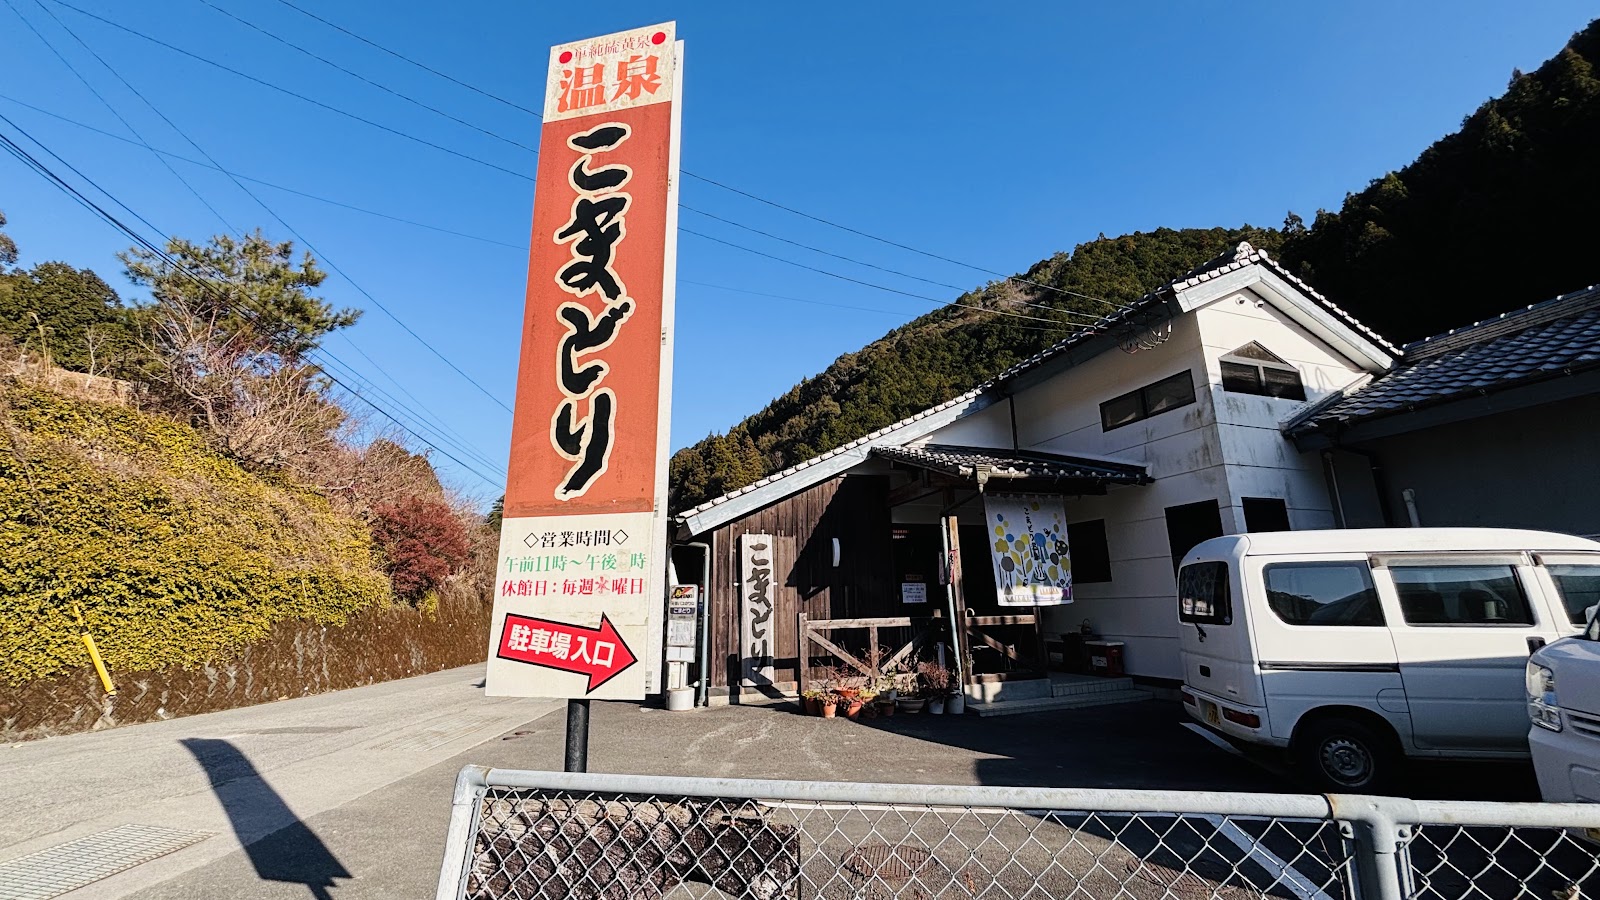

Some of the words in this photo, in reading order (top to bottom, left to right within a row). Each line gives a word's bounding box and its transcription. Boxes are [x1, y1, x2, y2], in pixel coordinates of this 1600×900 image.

[558, 55, 661, 113] 温泉
[555, 124, 633, 499] こまどり
[504, 552, 647, 573] 午前11時〜午後時
[541, 530, 611, 548] 営業時間
[746, 543, 773, 674] こまどり
